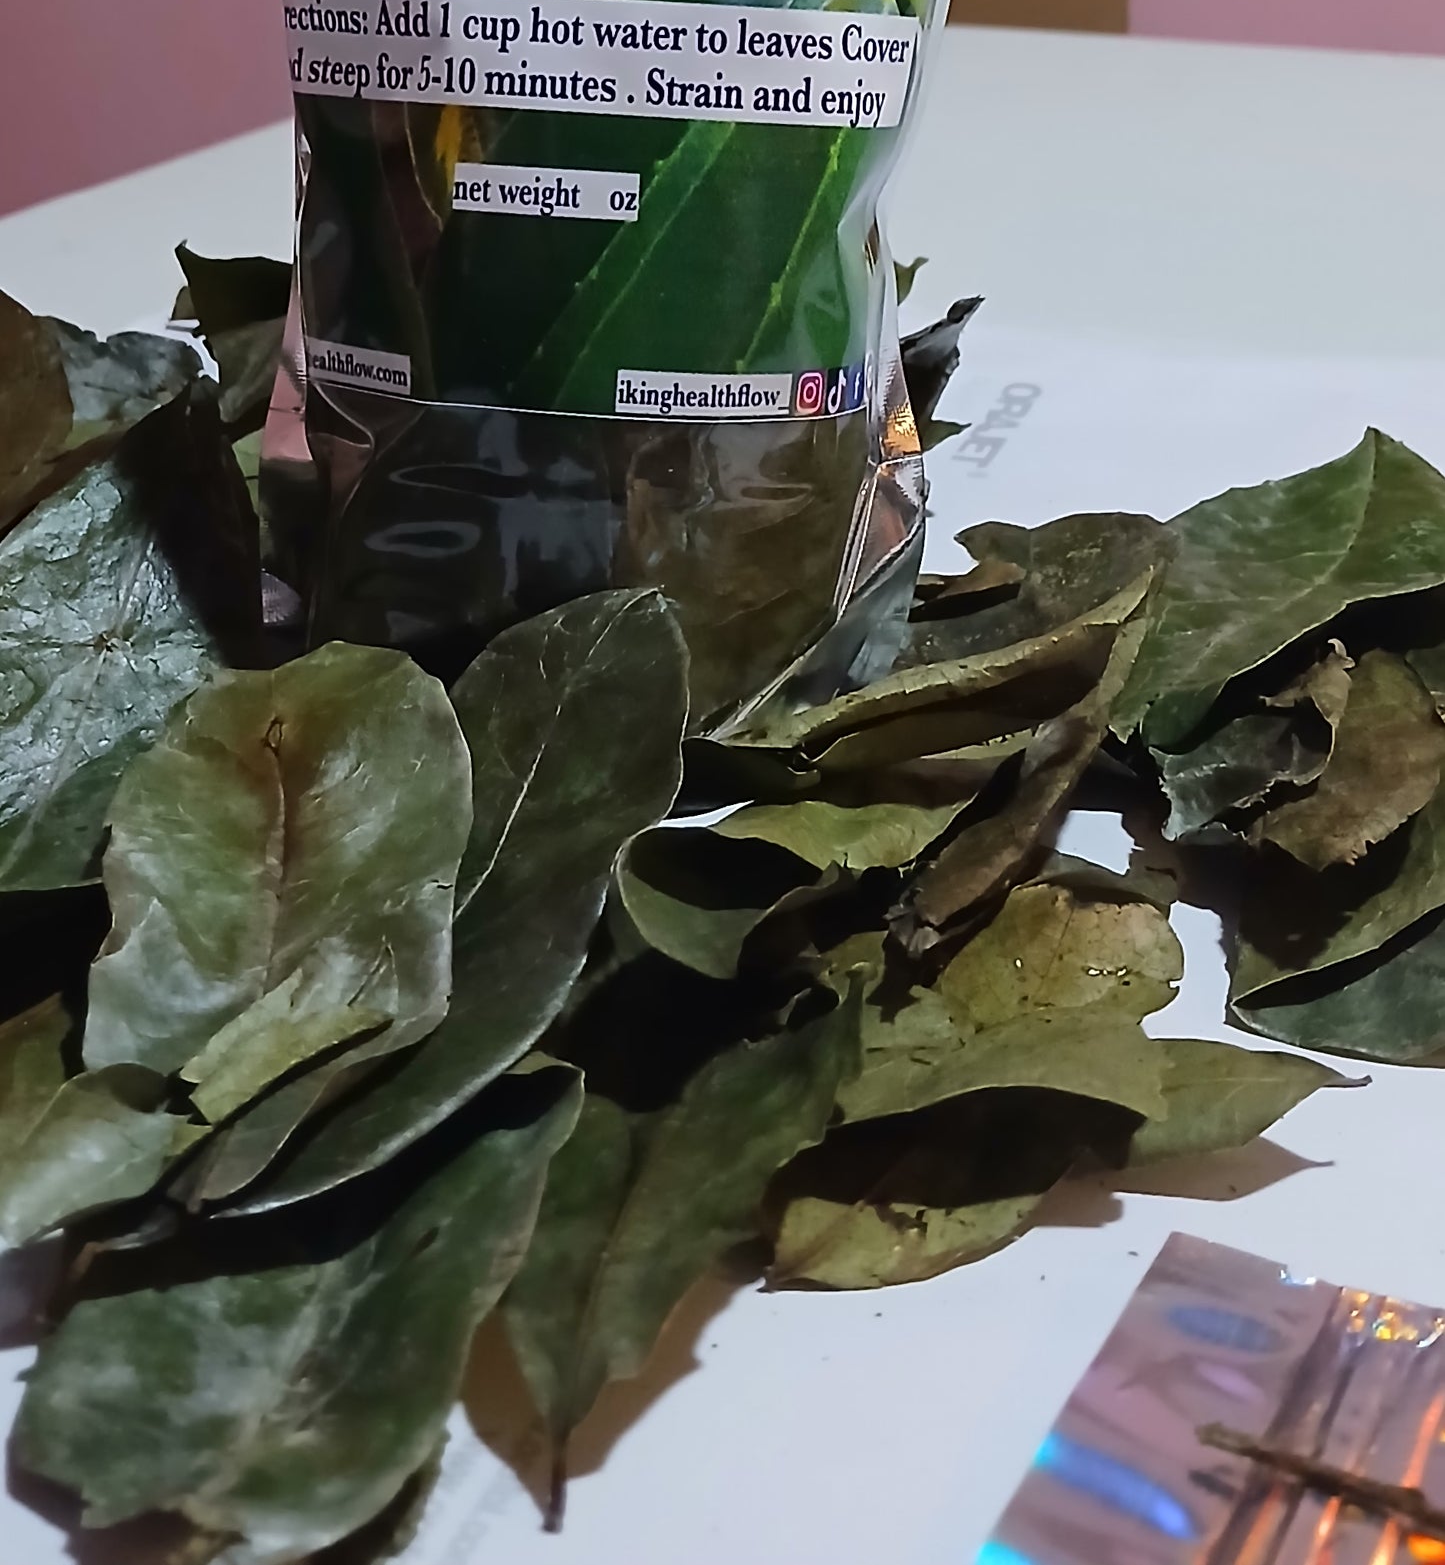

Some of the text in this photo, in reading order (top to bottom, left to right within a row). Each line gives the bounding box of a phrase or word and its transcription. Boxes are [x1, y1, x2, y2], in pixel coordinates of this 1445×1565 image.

[375, 0, 430, 37] Add
[440, 2, 451, 38] 1
[462, 13, 520, 53] cup
[529, 6, 584, 46] hot
[592, 20, 688, 51] water
[696, 22, 728, 54] to
[736, 18, 832, 60] leaves
[841, 24, 909, 63] Cover
[308, 56, 370, 99] steep
[377, 52, 413, 90] for
[417, 55, 476, 94] 5-10
[484, 60, 617, 103] minutes
[646, 67, 743, 110] Strain
[753, 77, 811, 113] and
[821, 79, 885, 128] enjoy
[453, 176, 637, 216] net weight oz
[311, 349, 408, 386] ealthflow.com
[617, 379, 790, 414] ikinghealthflow_
